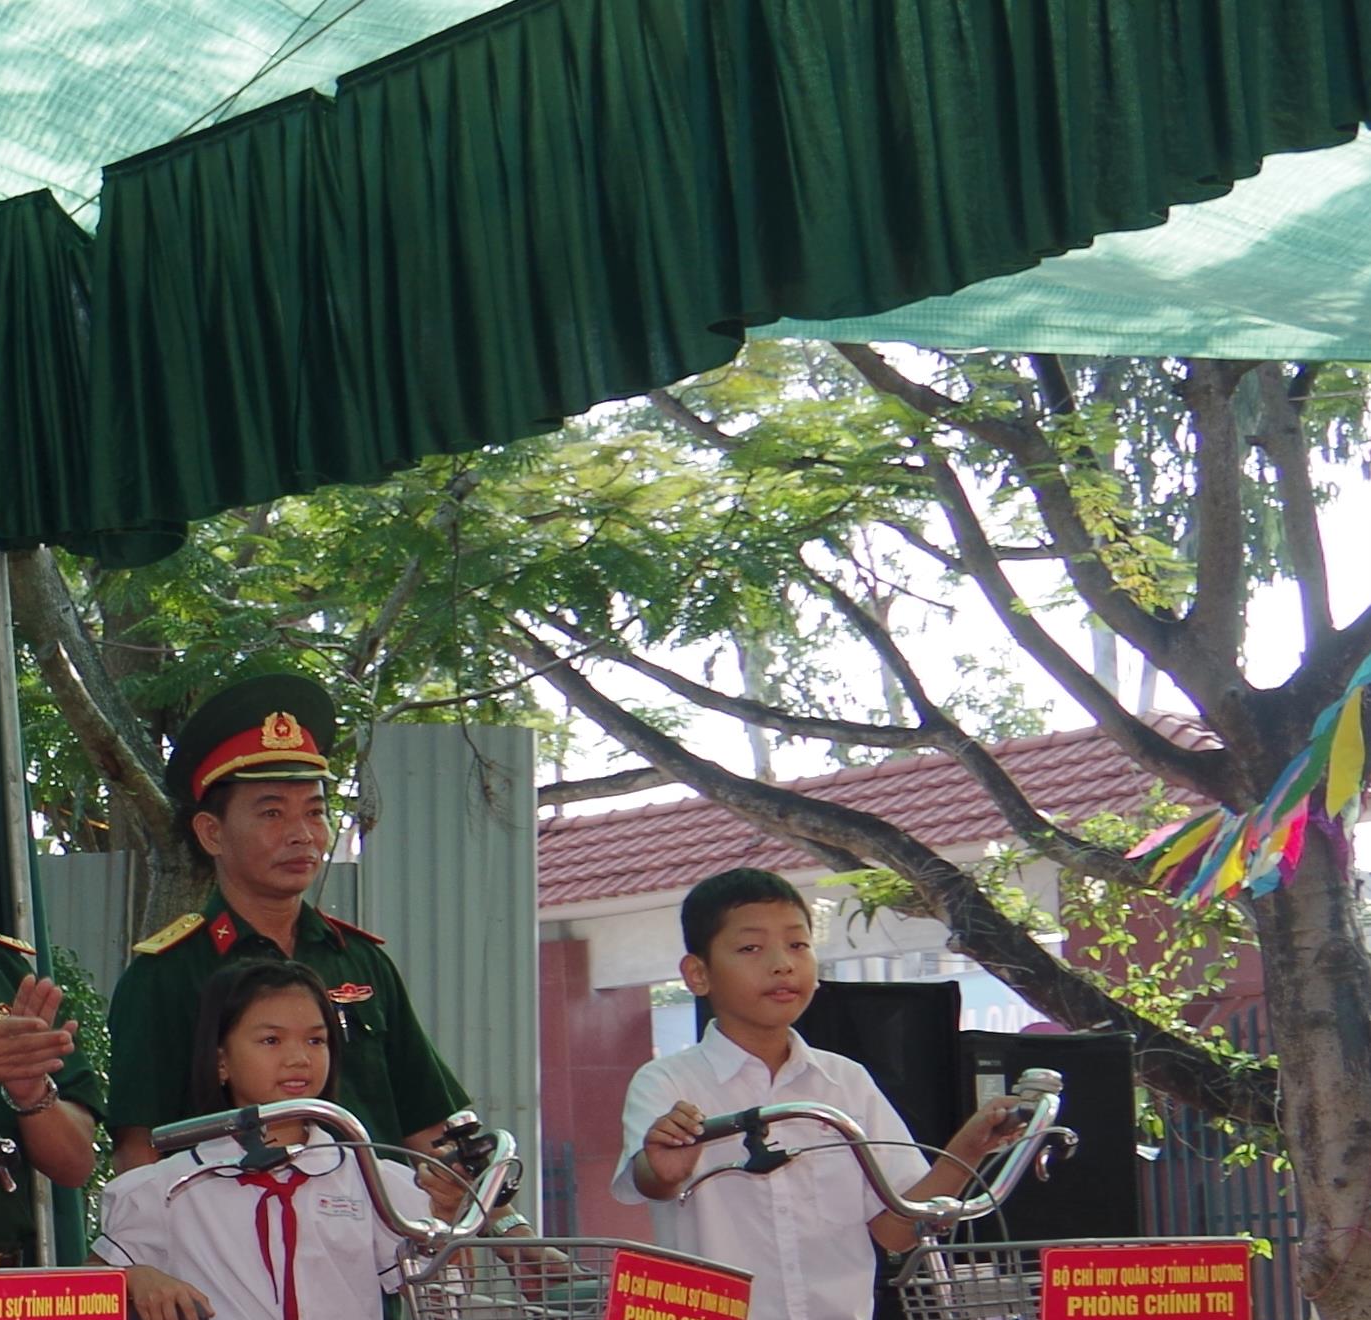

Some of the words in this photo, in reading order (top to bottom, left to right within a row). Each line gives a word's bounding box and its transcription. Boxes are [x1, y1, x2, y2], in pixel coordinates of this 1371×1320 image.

[1051, 1264, 1071, 1291] BỘ
[1095, 1267, 1119, 1287] HUY
[1119, 1263, 1150, 1288] QUÂN
[24, 1288, 54, 1318] TỈNH
[55, 1286, 77, 1317] HẢI
[78, 1292, 120, 1316] DƯƠNG
[1066, 1290, 1139, 1317] PHÒNG
[1143, 1289, 1201, 1316] CHÍNH
[1204, 1291, 1234, 1317] TRỊ
